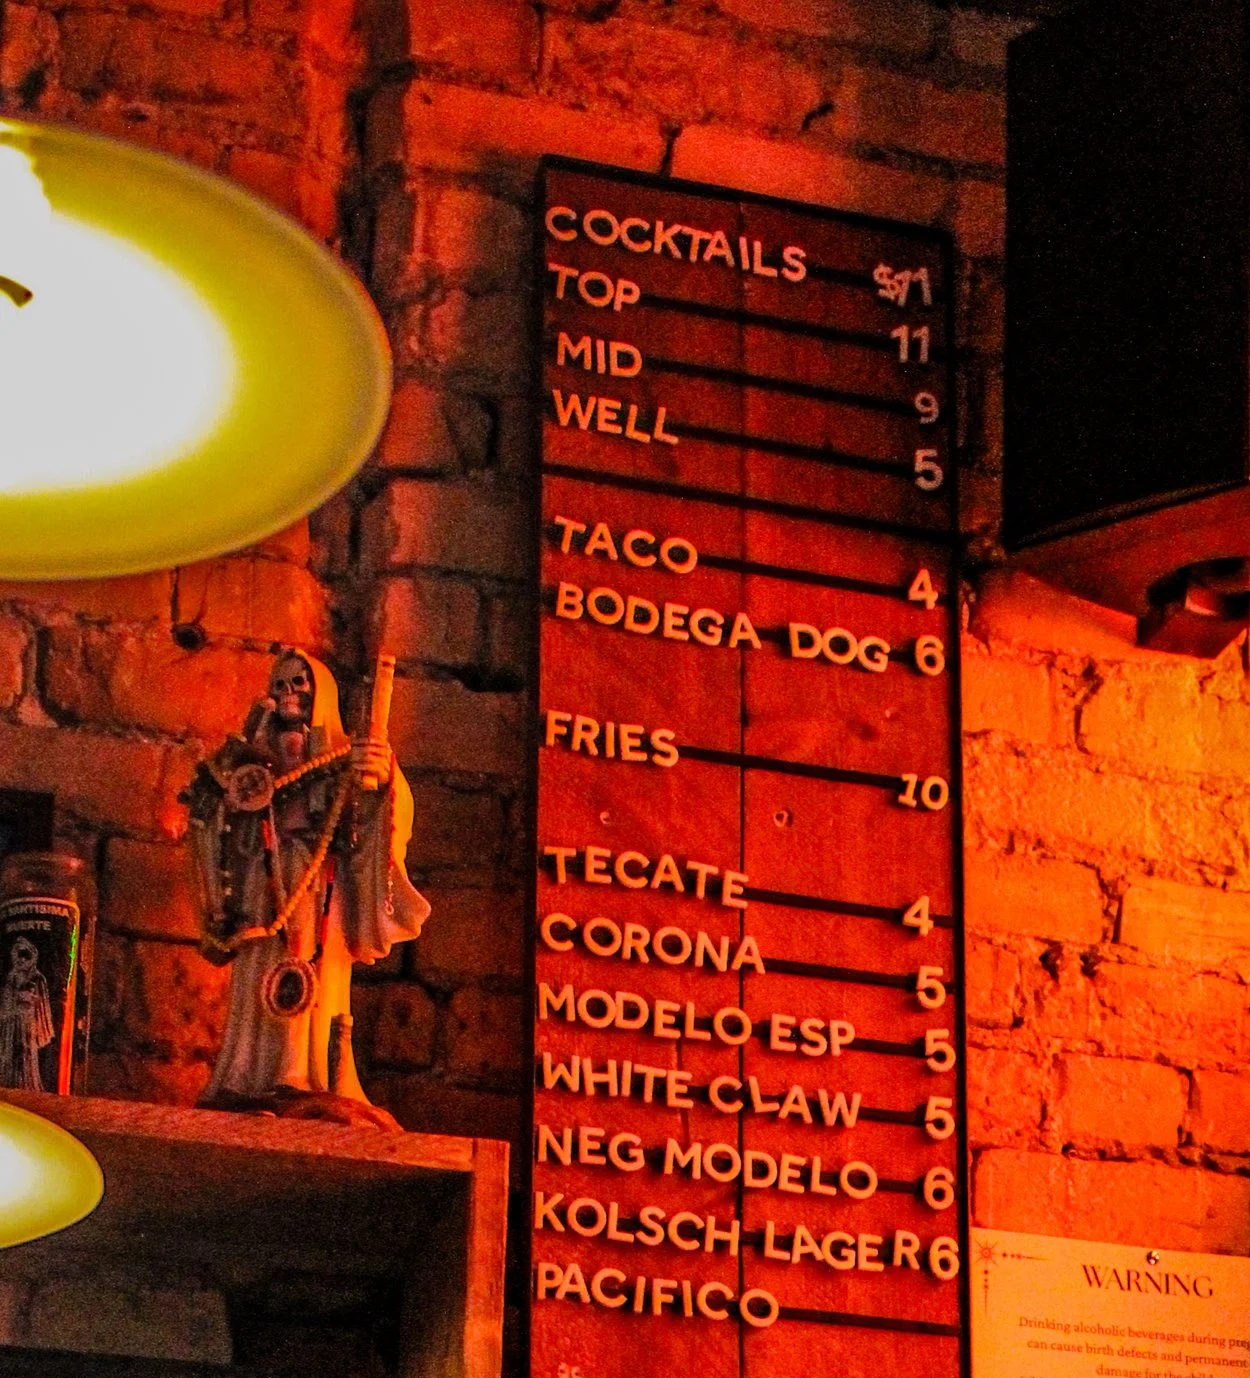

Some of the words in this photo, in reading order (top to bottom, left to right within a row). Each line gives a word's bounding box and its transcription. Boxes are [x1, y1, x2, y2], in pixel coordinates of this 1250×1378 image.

[545, 206, 807, 282] COCKTAILS
[547, 262, 640, 312] TOP
[891, 326, 929, 363] 11
[556, 332, 643, 378] MID
[914, 393, 939, 425] 9
[551, 389, 679, 446] WELL
[913, 449, 944, 491] 5
[553, 515, 699, 575] TACO
[907, 568, 939, 610] 4
[555, 581, 762, 650] BODEGA
[788, 621, 891, 673] DOG
[914, 635, 946, 677] 6
[545, 709, 680, 768] FRIES
[897, 772, 950, 811] 10
[543, 846, 749, 909] TECATE
[903, 895, 934, 937] 4
[541, 913, 766, 975] CORONA
[916, 965, 946, 1009] 5
[538, 982, 752, 1046] MODELO
[770, 1013, 856, 1057] ESP
[924, 1028, 956, 1073] 5
[542, 1052, 694, 1109] WHITE
[708, 1075, 862, 1128] CLAW
[924, 1096, 955, 1140] 5
[538, 1124, 645, 1172] NEG
[664, 1136, 878, 1200] MODELO
[924, 1166, 955, 1211] 6
[534, 1191, 741, 1257] KOLSCH
[764, 1220, 921, 1272] LAGER
[928, 1236, 960, 1281] 6
[1082, 1264, 1214, 1299] WARNING
[537, 1261, 779, 1328] PACIFICO
[1019, 1317, 1071, 1335] Drinking
[1074, 1322, 1125, 1337] alcoholic
[1128, 1327, 1185, 1343] beverages
[1187, 1332, 1226, 1348] during
[1027, 1340, 1047, 1350] can
[1050, 1342, 1083, 1353] cause
[1086, 1342, 1114, 1357] birth
[1117, 1347, 1158, 1360] defects
[1161, 1352, 1183, 1362] and
[1185, 1354, 1248, 1368] permanent
